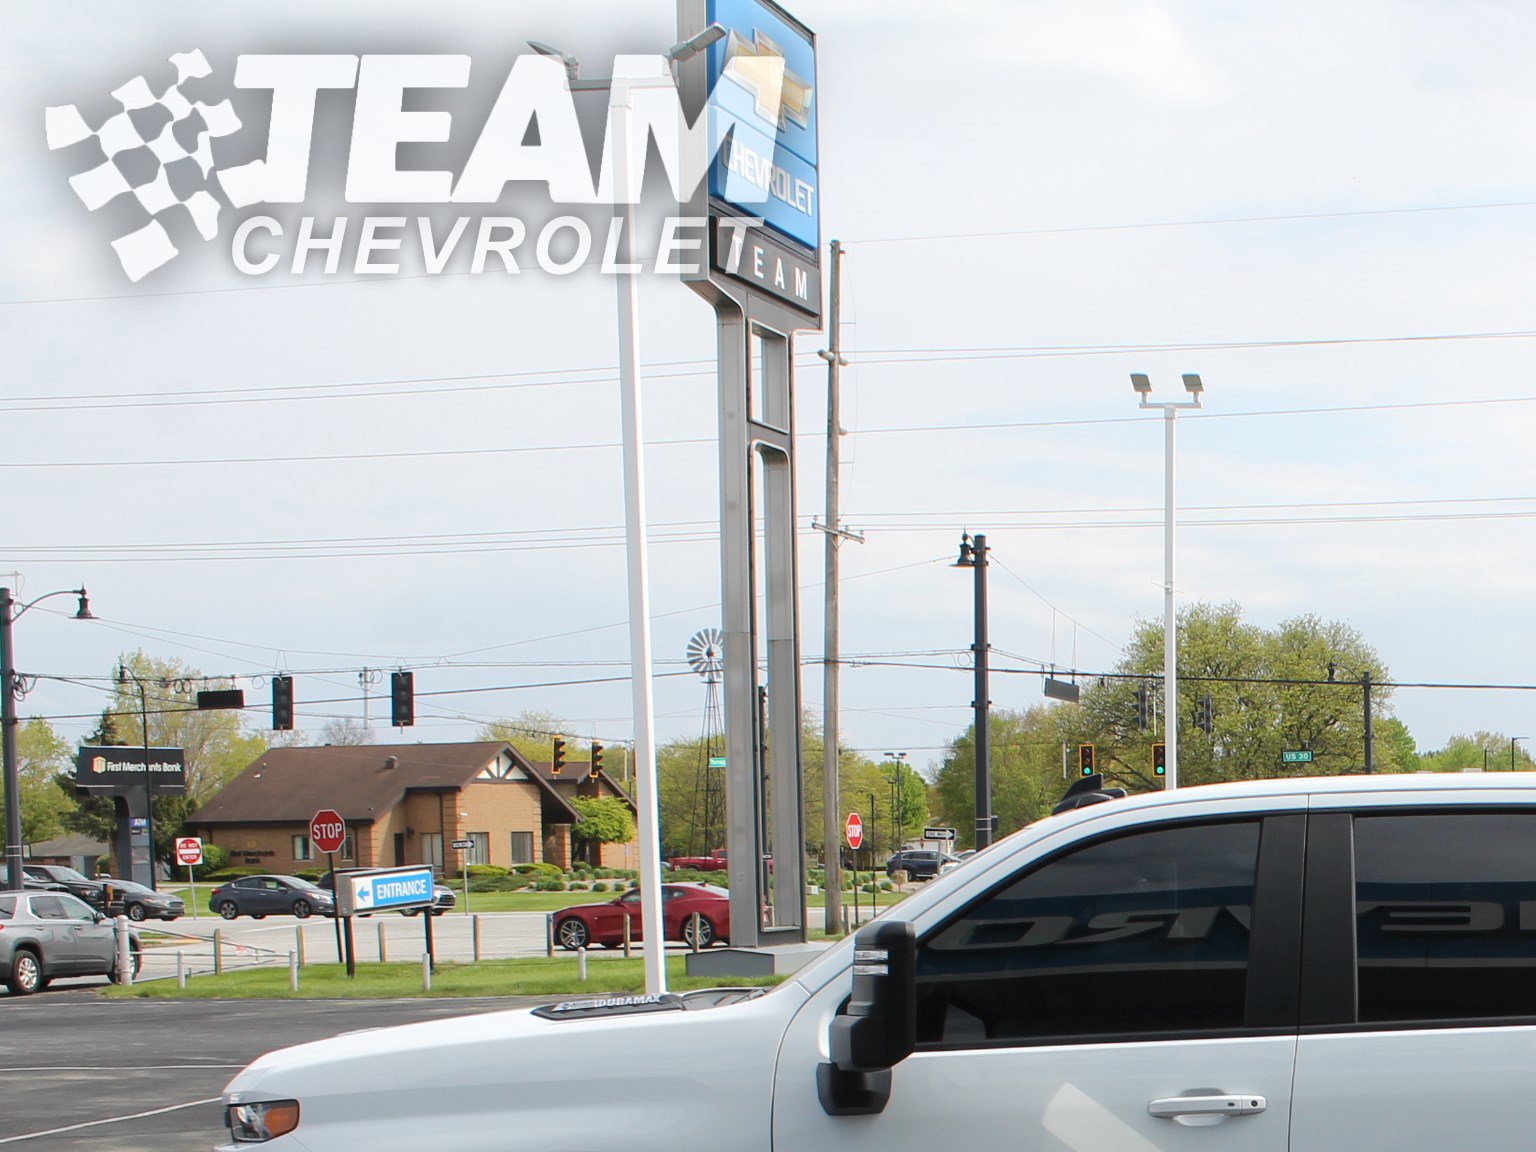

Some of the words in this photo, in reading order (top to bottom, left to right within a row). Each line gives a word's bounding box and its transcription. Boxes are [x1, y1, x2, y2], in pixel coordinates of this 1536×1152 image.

[722, 138, 815, 217] CHEVROLET
[732, 232, 808, 301] TEAM
[1285, 752, 1296, 760] US
[1298, 752, 1309, 760] 30
[107, 761, 121, 772] First
[162, 761, 182, 772] Bank
[313, 822, 343, 840] STOP
[847, 824, 862, 838] STOP
[376, 879, 428, 900] ENTRANCE
[598, 995, 661, 1008] DURAMAX
